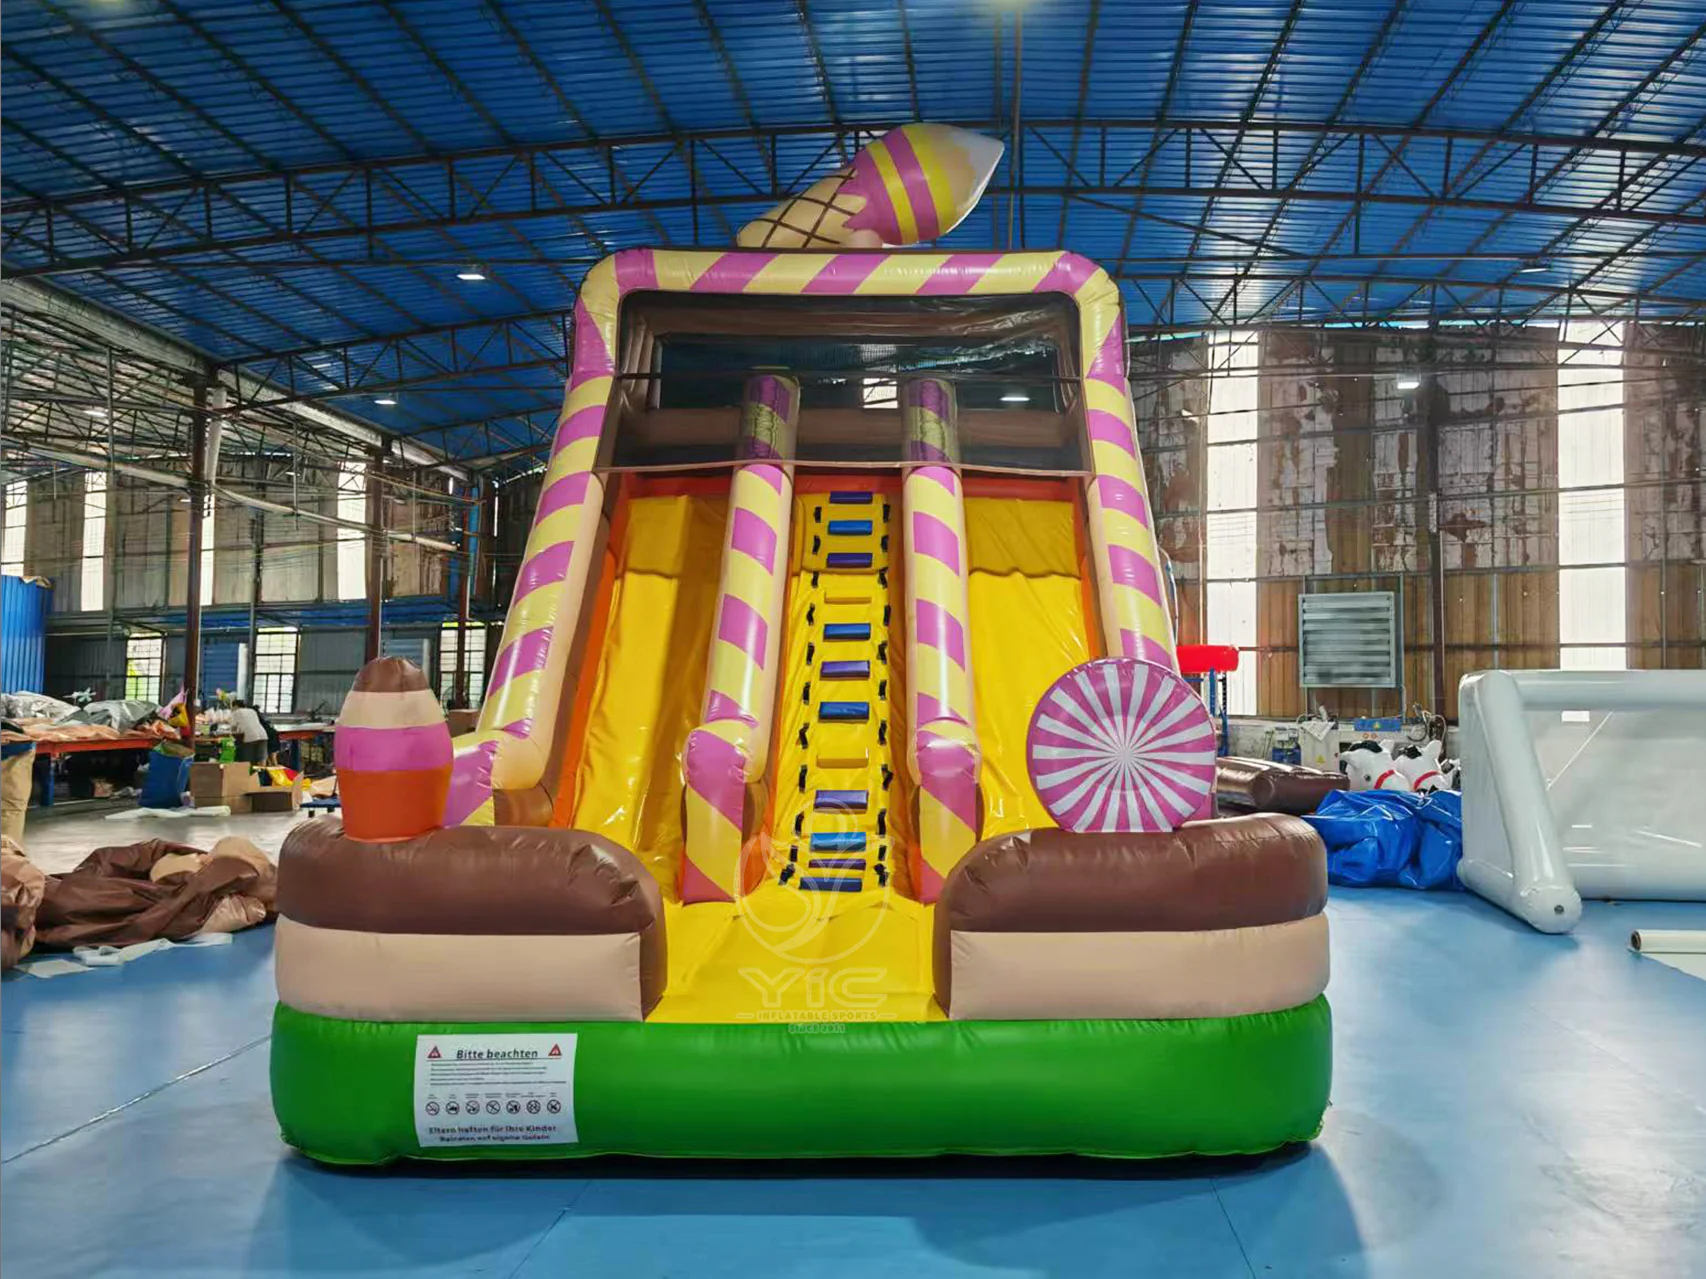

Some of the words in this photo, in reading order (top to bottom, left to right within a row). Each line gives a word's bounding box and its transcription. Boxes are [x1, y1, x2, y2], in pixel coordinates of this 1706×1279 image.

[456, 1049, 484, 1059] Bitte
[486, 1048, 538, 1059] beachten
[458, 1126, 488, 1134] haften
